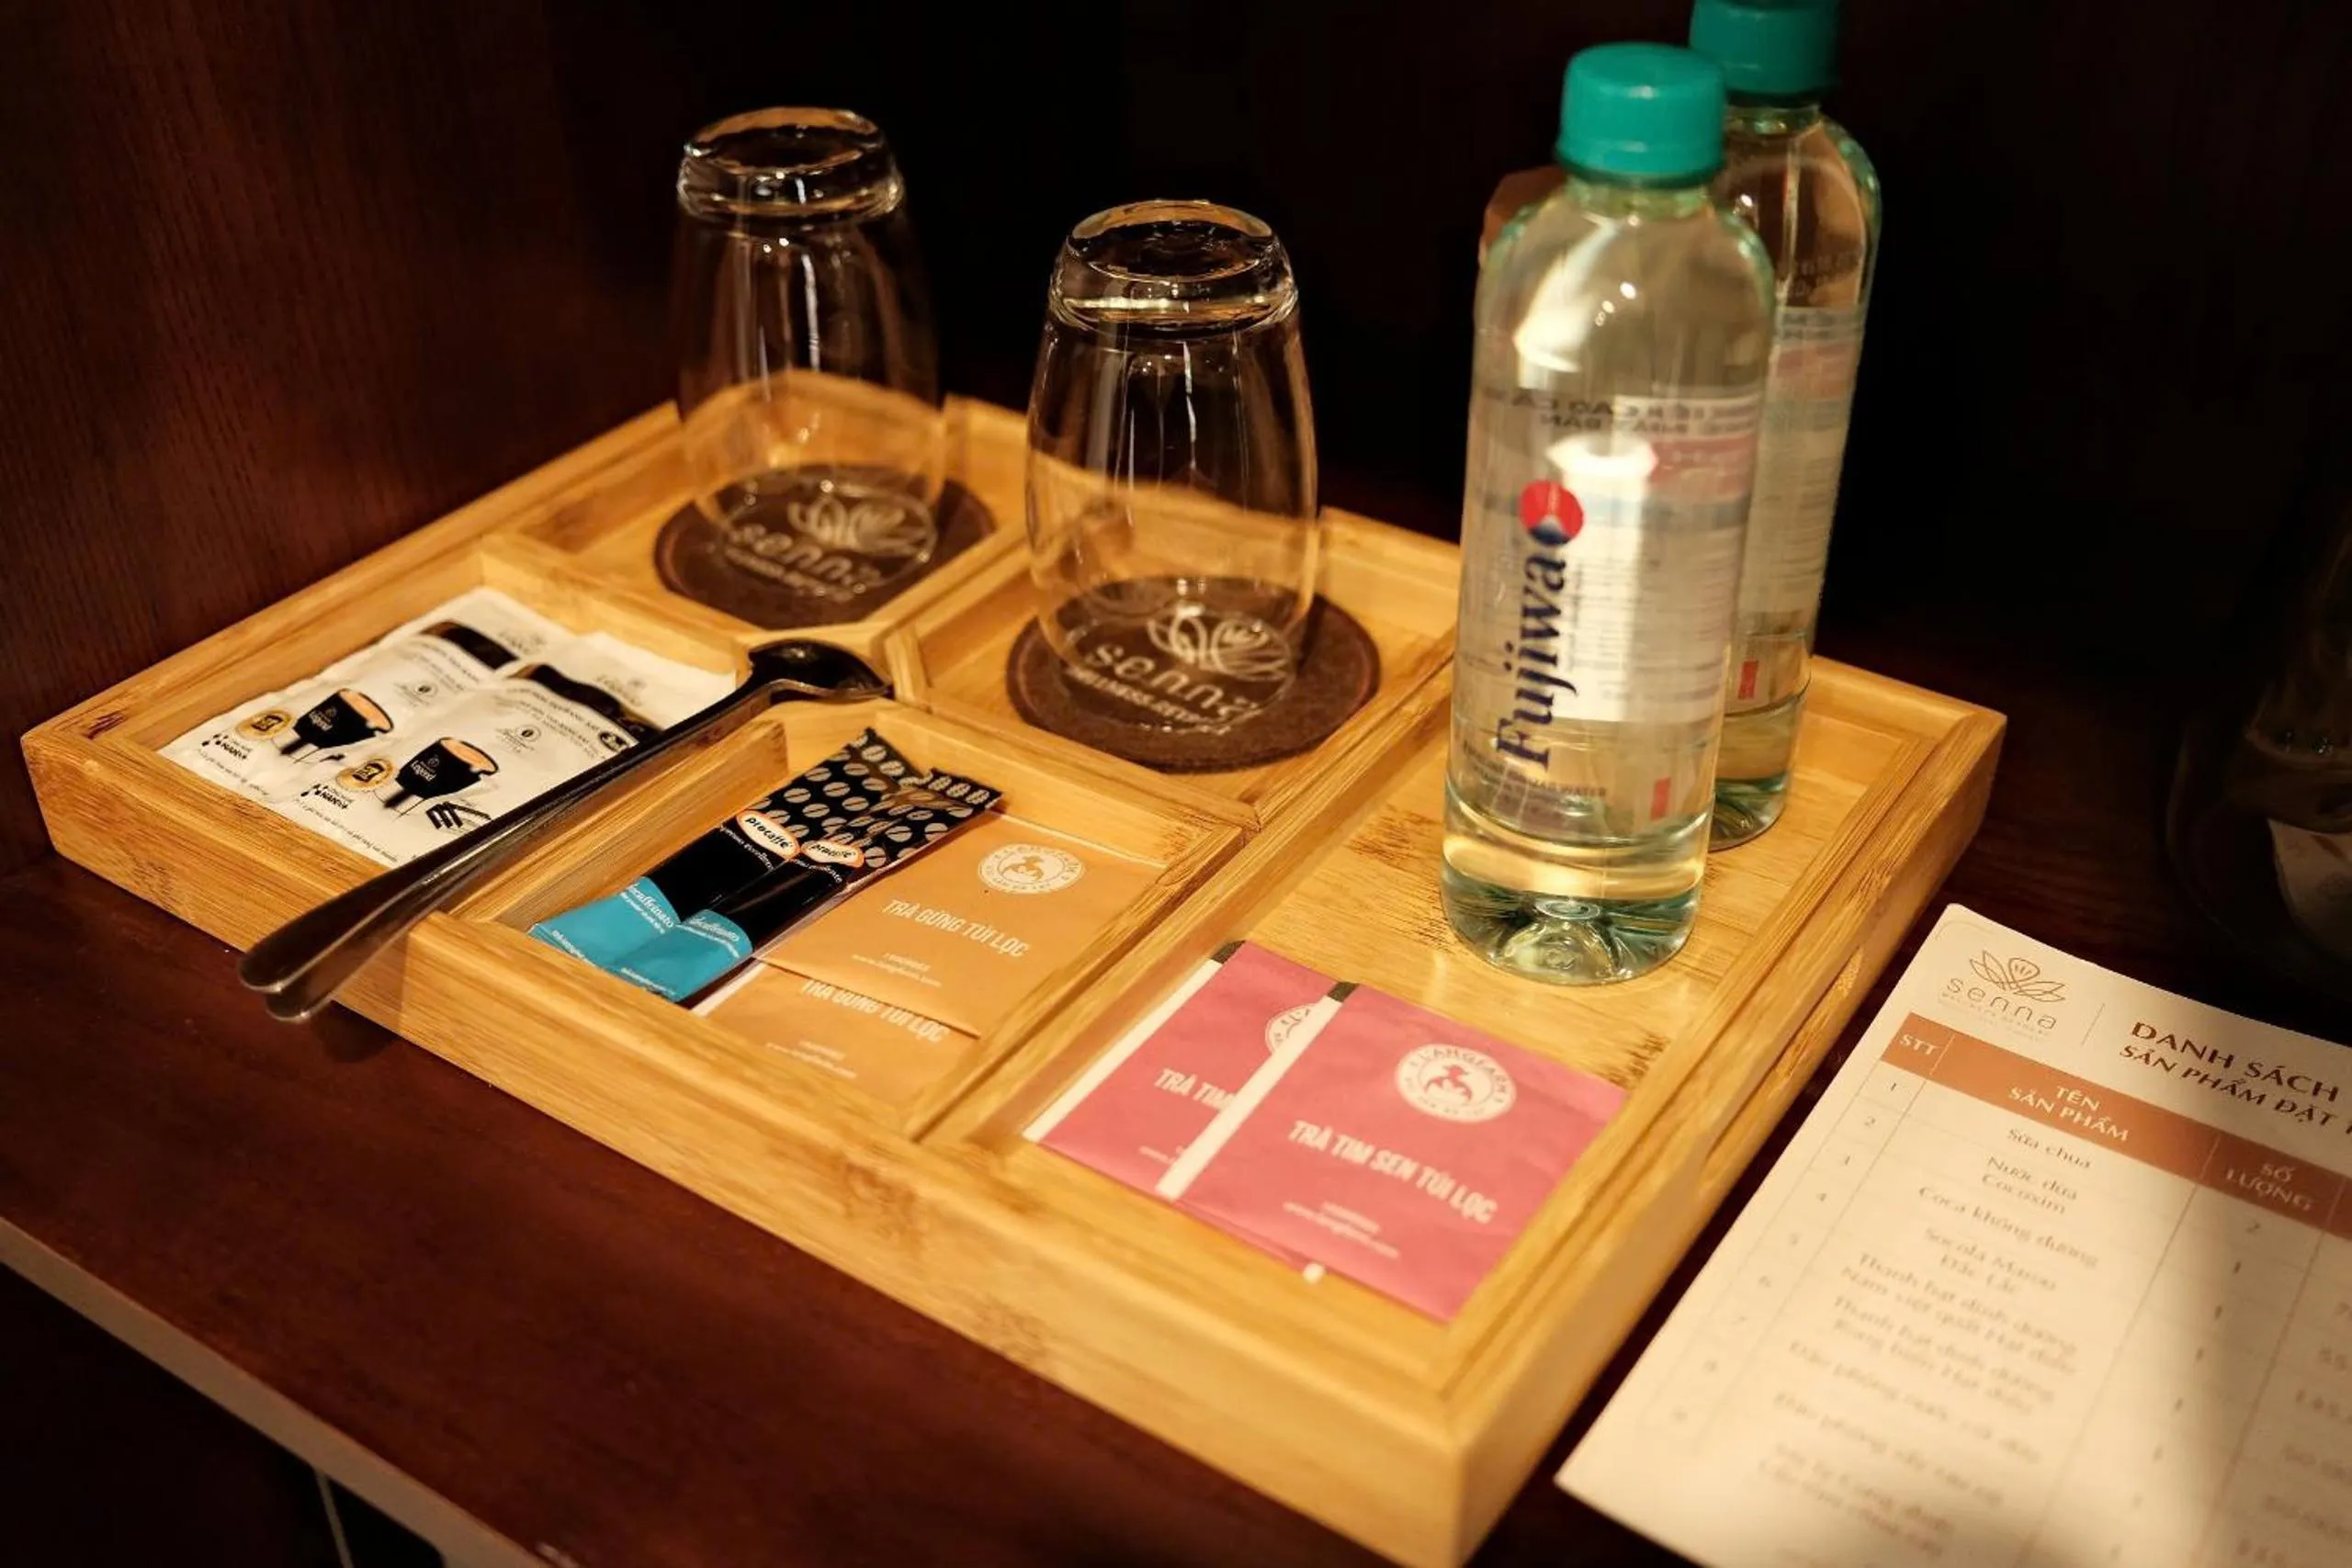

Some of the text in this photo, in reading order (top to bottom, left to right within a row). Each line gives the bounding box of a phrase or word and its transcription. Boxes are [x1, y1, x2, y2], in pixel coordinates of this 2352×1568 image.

[1496, 553, 1578, 772] Fujiwa
[988, 932, 1031, 958] LỌC
[1945, 977, 2058, 1031] senna
[1898, 1033, 1940, 1056] STT
[2131, 1021, 2339, 1102] DANH SÁCH
[2055, 1085, 2101, 1111] TÊN
[2119, 1044, 2338, 1127] SẢN PHẨM ĐẶT
[2008, 1085, 2130, 1143] SẢN PHẨM
[1331, 1134, 1375, 1165] TIM
[1369, 1149, 1419, 1182] SEN
